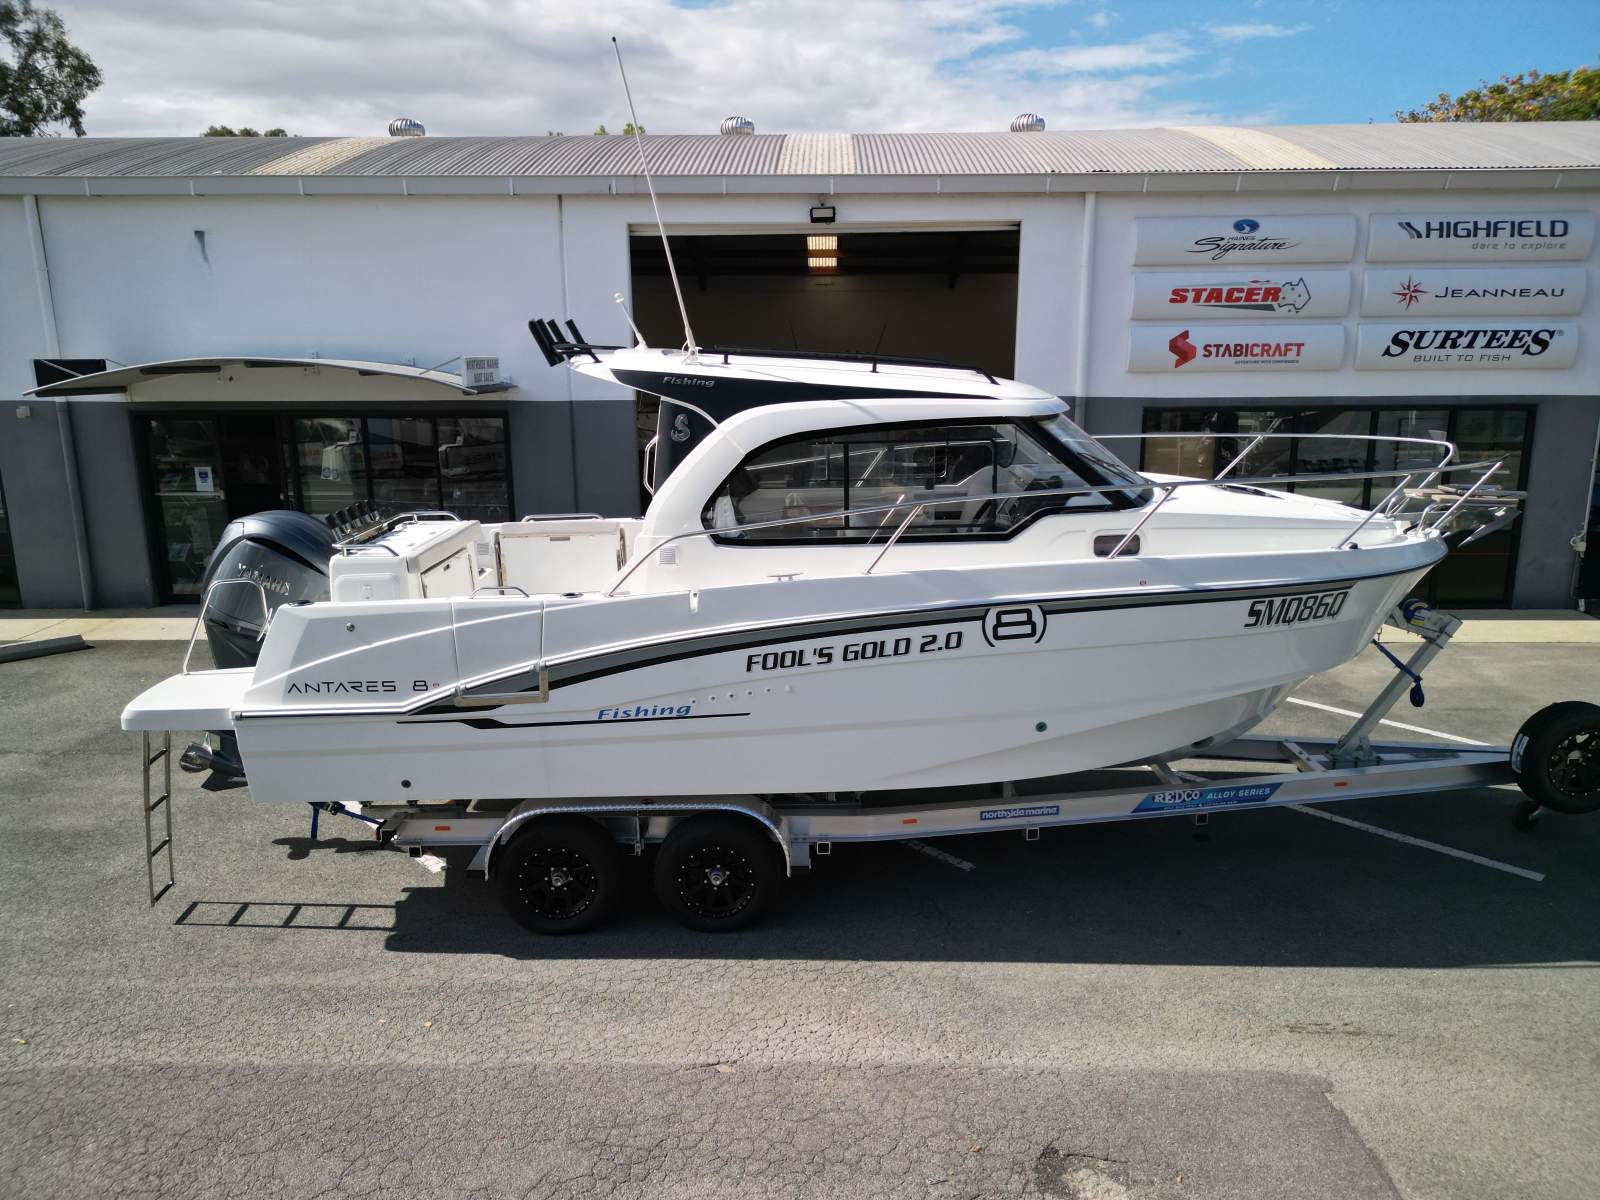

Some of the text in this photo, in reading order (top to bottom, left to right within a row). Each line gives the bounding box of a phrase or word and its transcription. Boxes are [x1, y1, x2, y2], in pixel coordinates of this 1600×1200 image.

[1425, 220, 1569, 239] HIGHFIELD
[1184, 236, 1303, 261] Signature
[1471, 241, 1567, 251] dare to explore
[1168, 287, 1282, 304] STACER
[1434, 286, 1565, 299] JEANNEAU
[1202, 343, 1305, 358] STABICRAFT
[1381, 328, 1556, 358] SURTEES
[1413, 354, 1512, 363] BUILT TO FISH
[662, 376, 716, 388] Fishing
[238, 562, 290, 596] YAMAHA
[746, 631, 963, 673] FOOL'S GOLD 2.0
[287, 680, 397, 694] ANTARES
[412, 680, 429, 692] 8
[598, 704, 692, 720] Fishing
[1153, 787, 1271, 804] REDCO ALLOY SERIES
[982, 806, 1058, 819] northside marine
